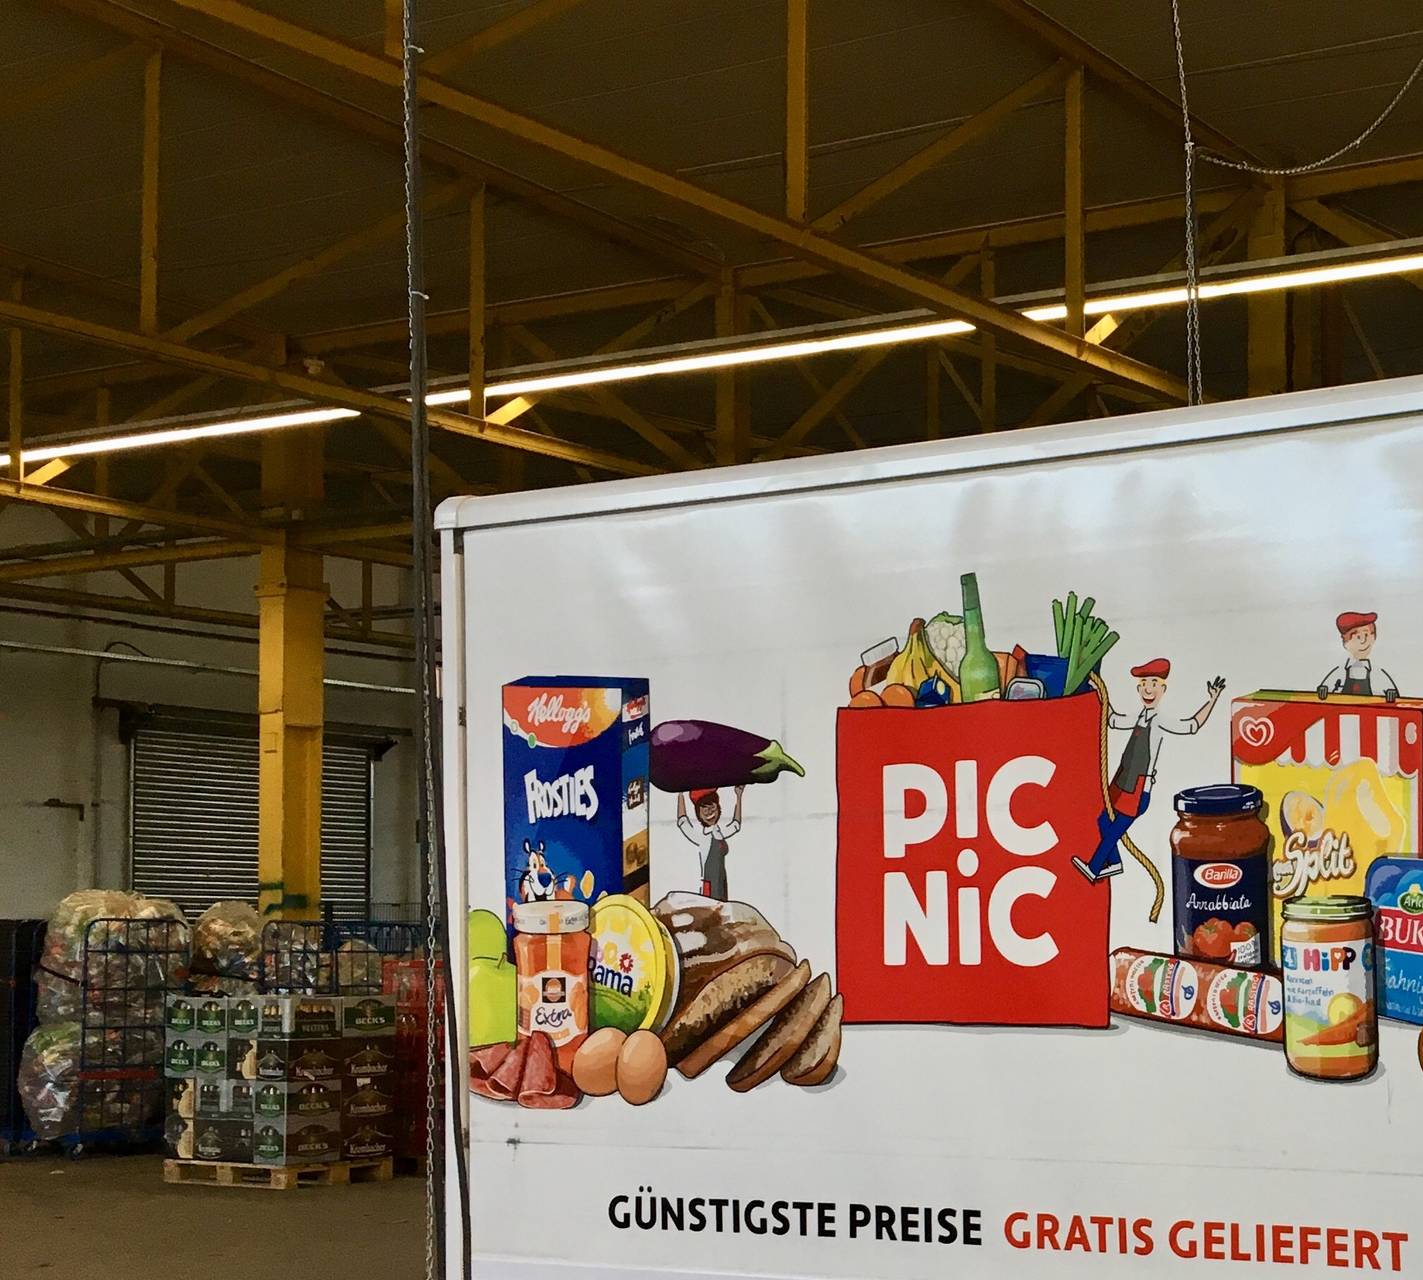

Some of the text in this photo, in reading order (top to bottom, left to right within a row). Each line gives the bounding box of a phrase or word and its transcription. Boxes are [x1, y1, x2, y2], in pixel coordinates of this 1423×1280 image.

[527, 692, 591, 734] Kellogg's
[524, 764, 599, 824] FROSTIES
[882, 755, 1060, 860] PIC
[1204, 868, 1239, 880] Barilla
[1273, 830, 1354, 897] Split
[1303, 946, 1357, 972] HiPP
[535, 1006, 572, 1028] Extra
[608, 1187, 1409, 1272] GÜNSTIGSTE PREISE GRATIS GELIEFERT
